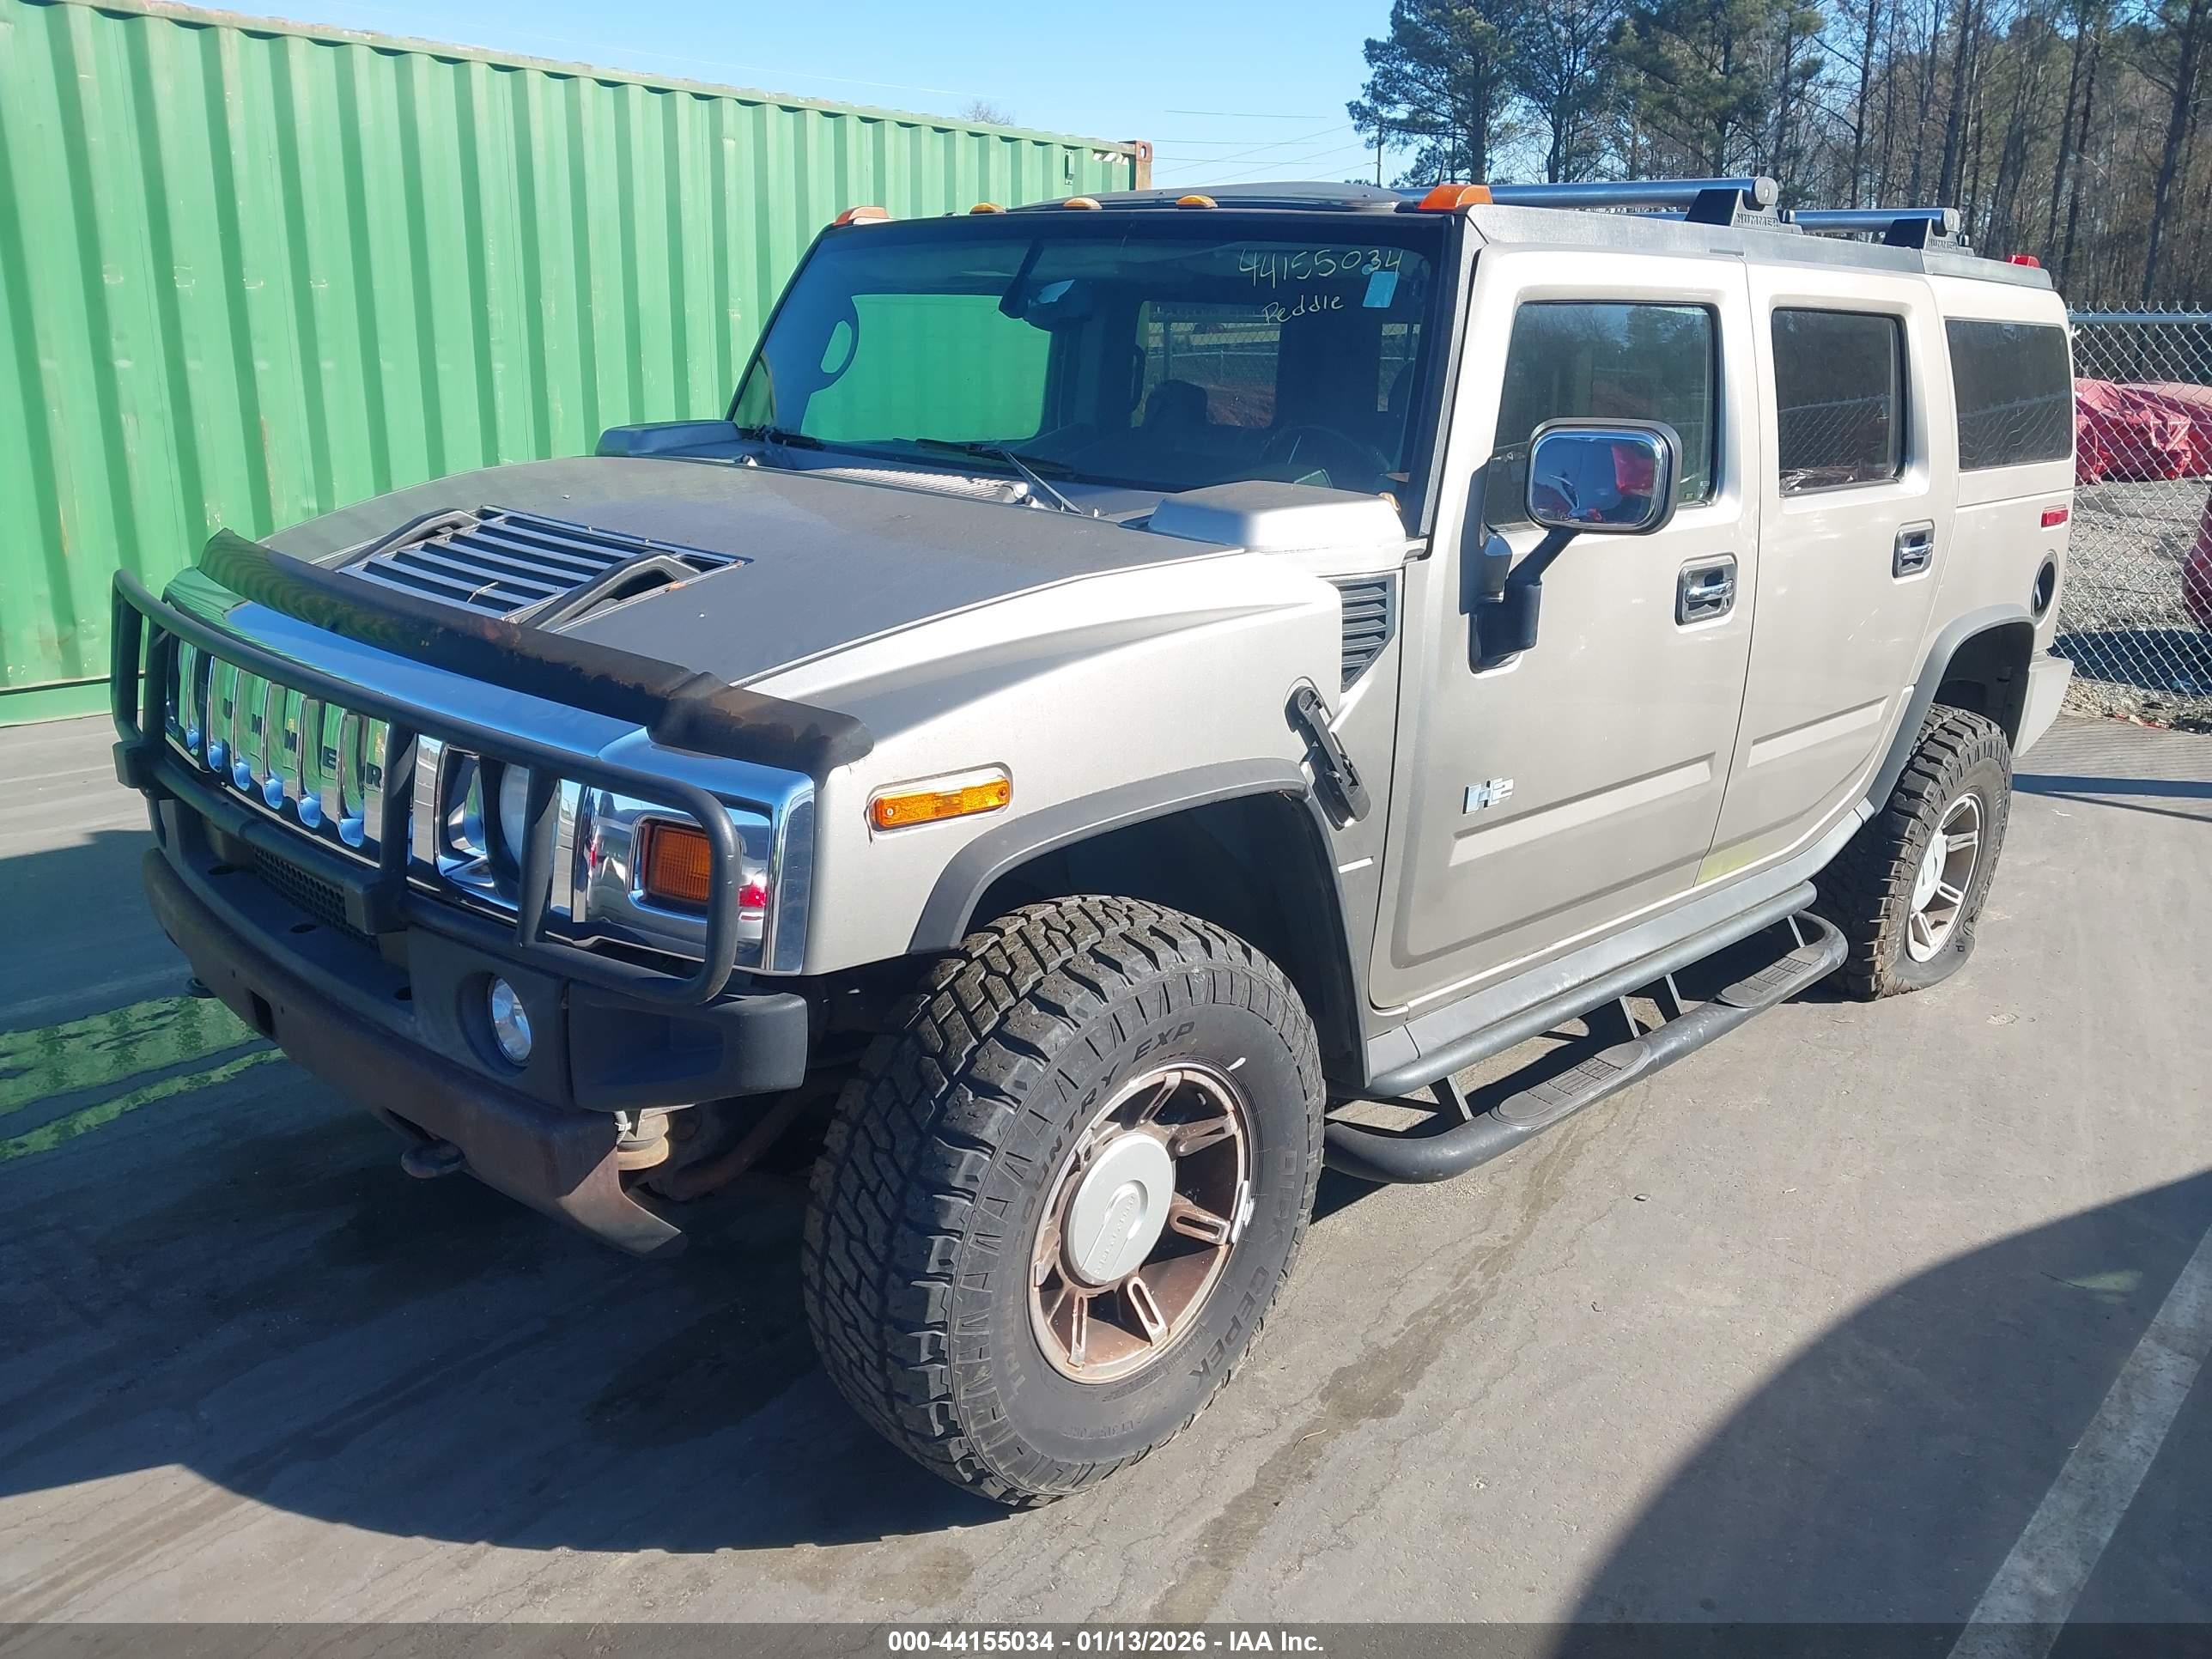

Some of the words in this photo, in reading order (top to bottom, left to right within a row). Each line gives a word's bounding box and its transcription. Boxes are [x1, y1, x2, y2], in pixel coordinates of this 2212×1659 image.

[1736, 212, 1780, 228] HUMMER
[1239, 248, 1403, 289] 44155034
[1262, 295, 1344, 323] Peddle
[198, 680, 384, 788] UMMER
[1133, 1020, 1195, 1062] EXP
[1188, 1266, 1271, 1394] CEPEK
